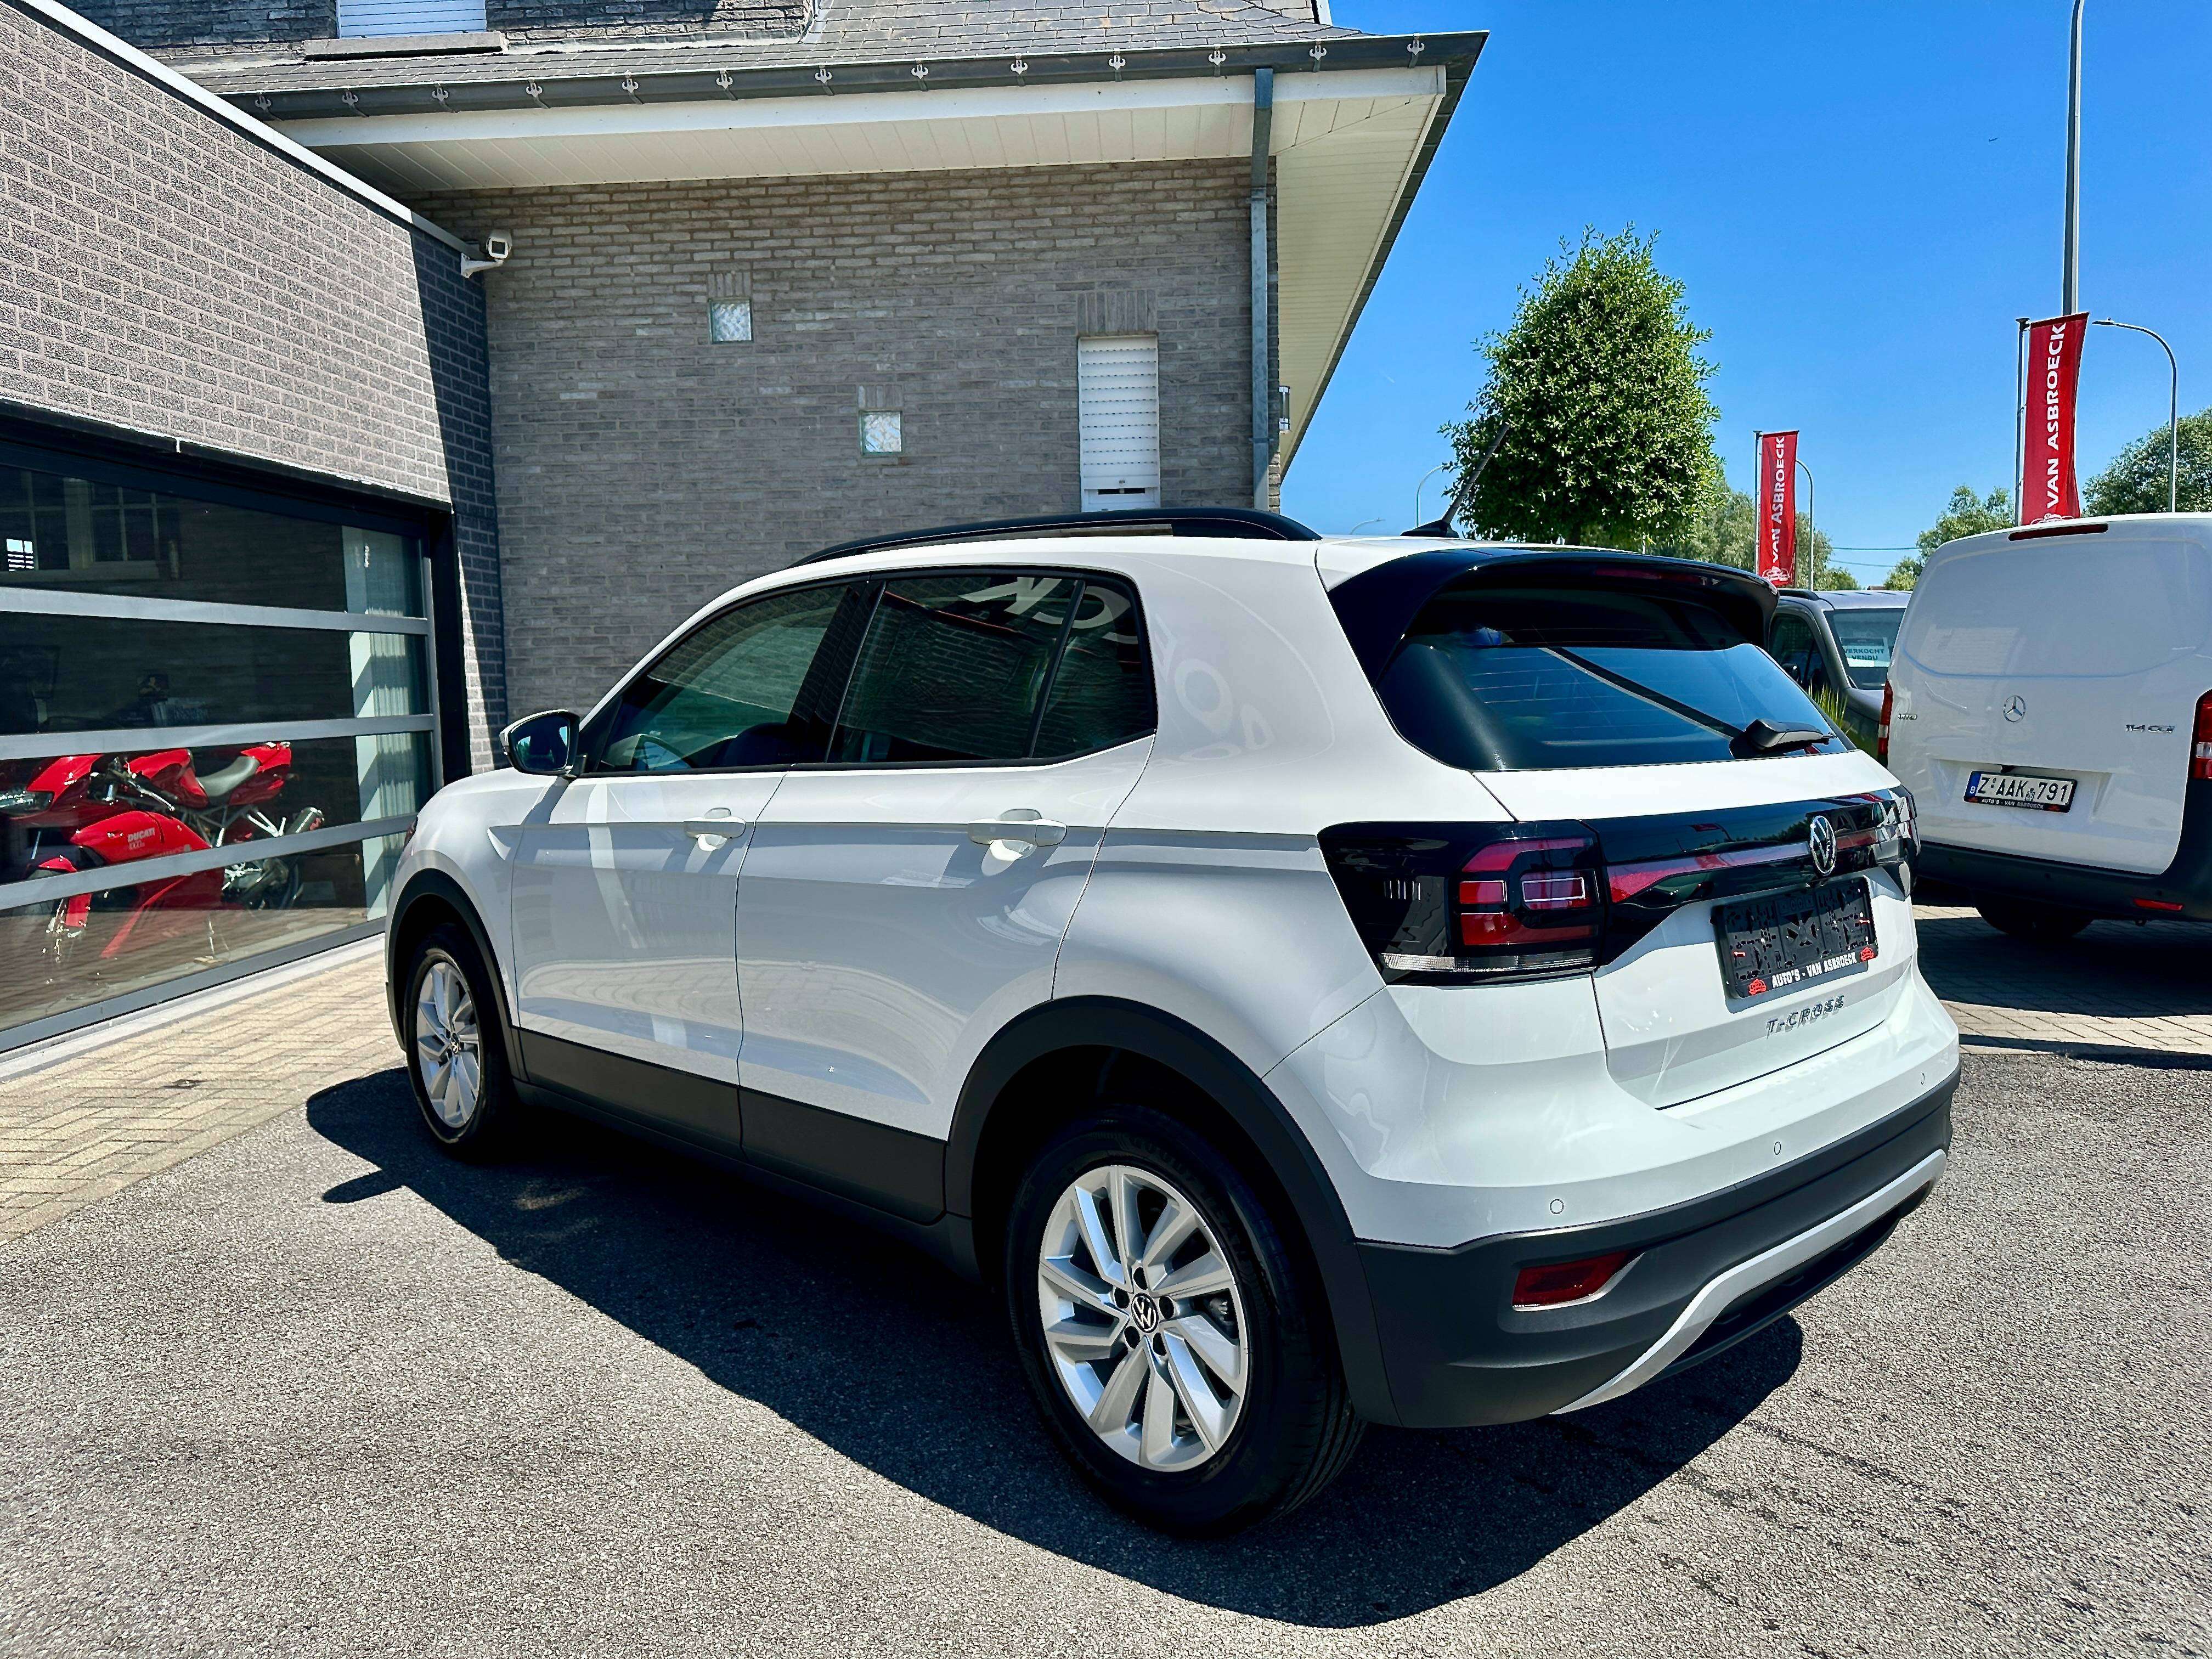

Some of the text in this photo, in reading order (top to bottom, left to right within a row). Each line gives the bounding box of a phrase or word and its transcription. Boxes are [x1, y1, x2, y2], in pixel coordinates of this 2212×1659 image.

[2046, 321, 2067, 509] VAN ASBROECK
[1771, 437, 1785, 563] VAN ASBROECK
[127, 827, 155, 843] DUCATI
[1771, 968, 1801, 989] AUTO'S
[1806, 962, 1822, 977] VAN
[1823, 952, 1857, 973] ASBROECK
[1766, 995, 1845, 1037] T-CROSS
